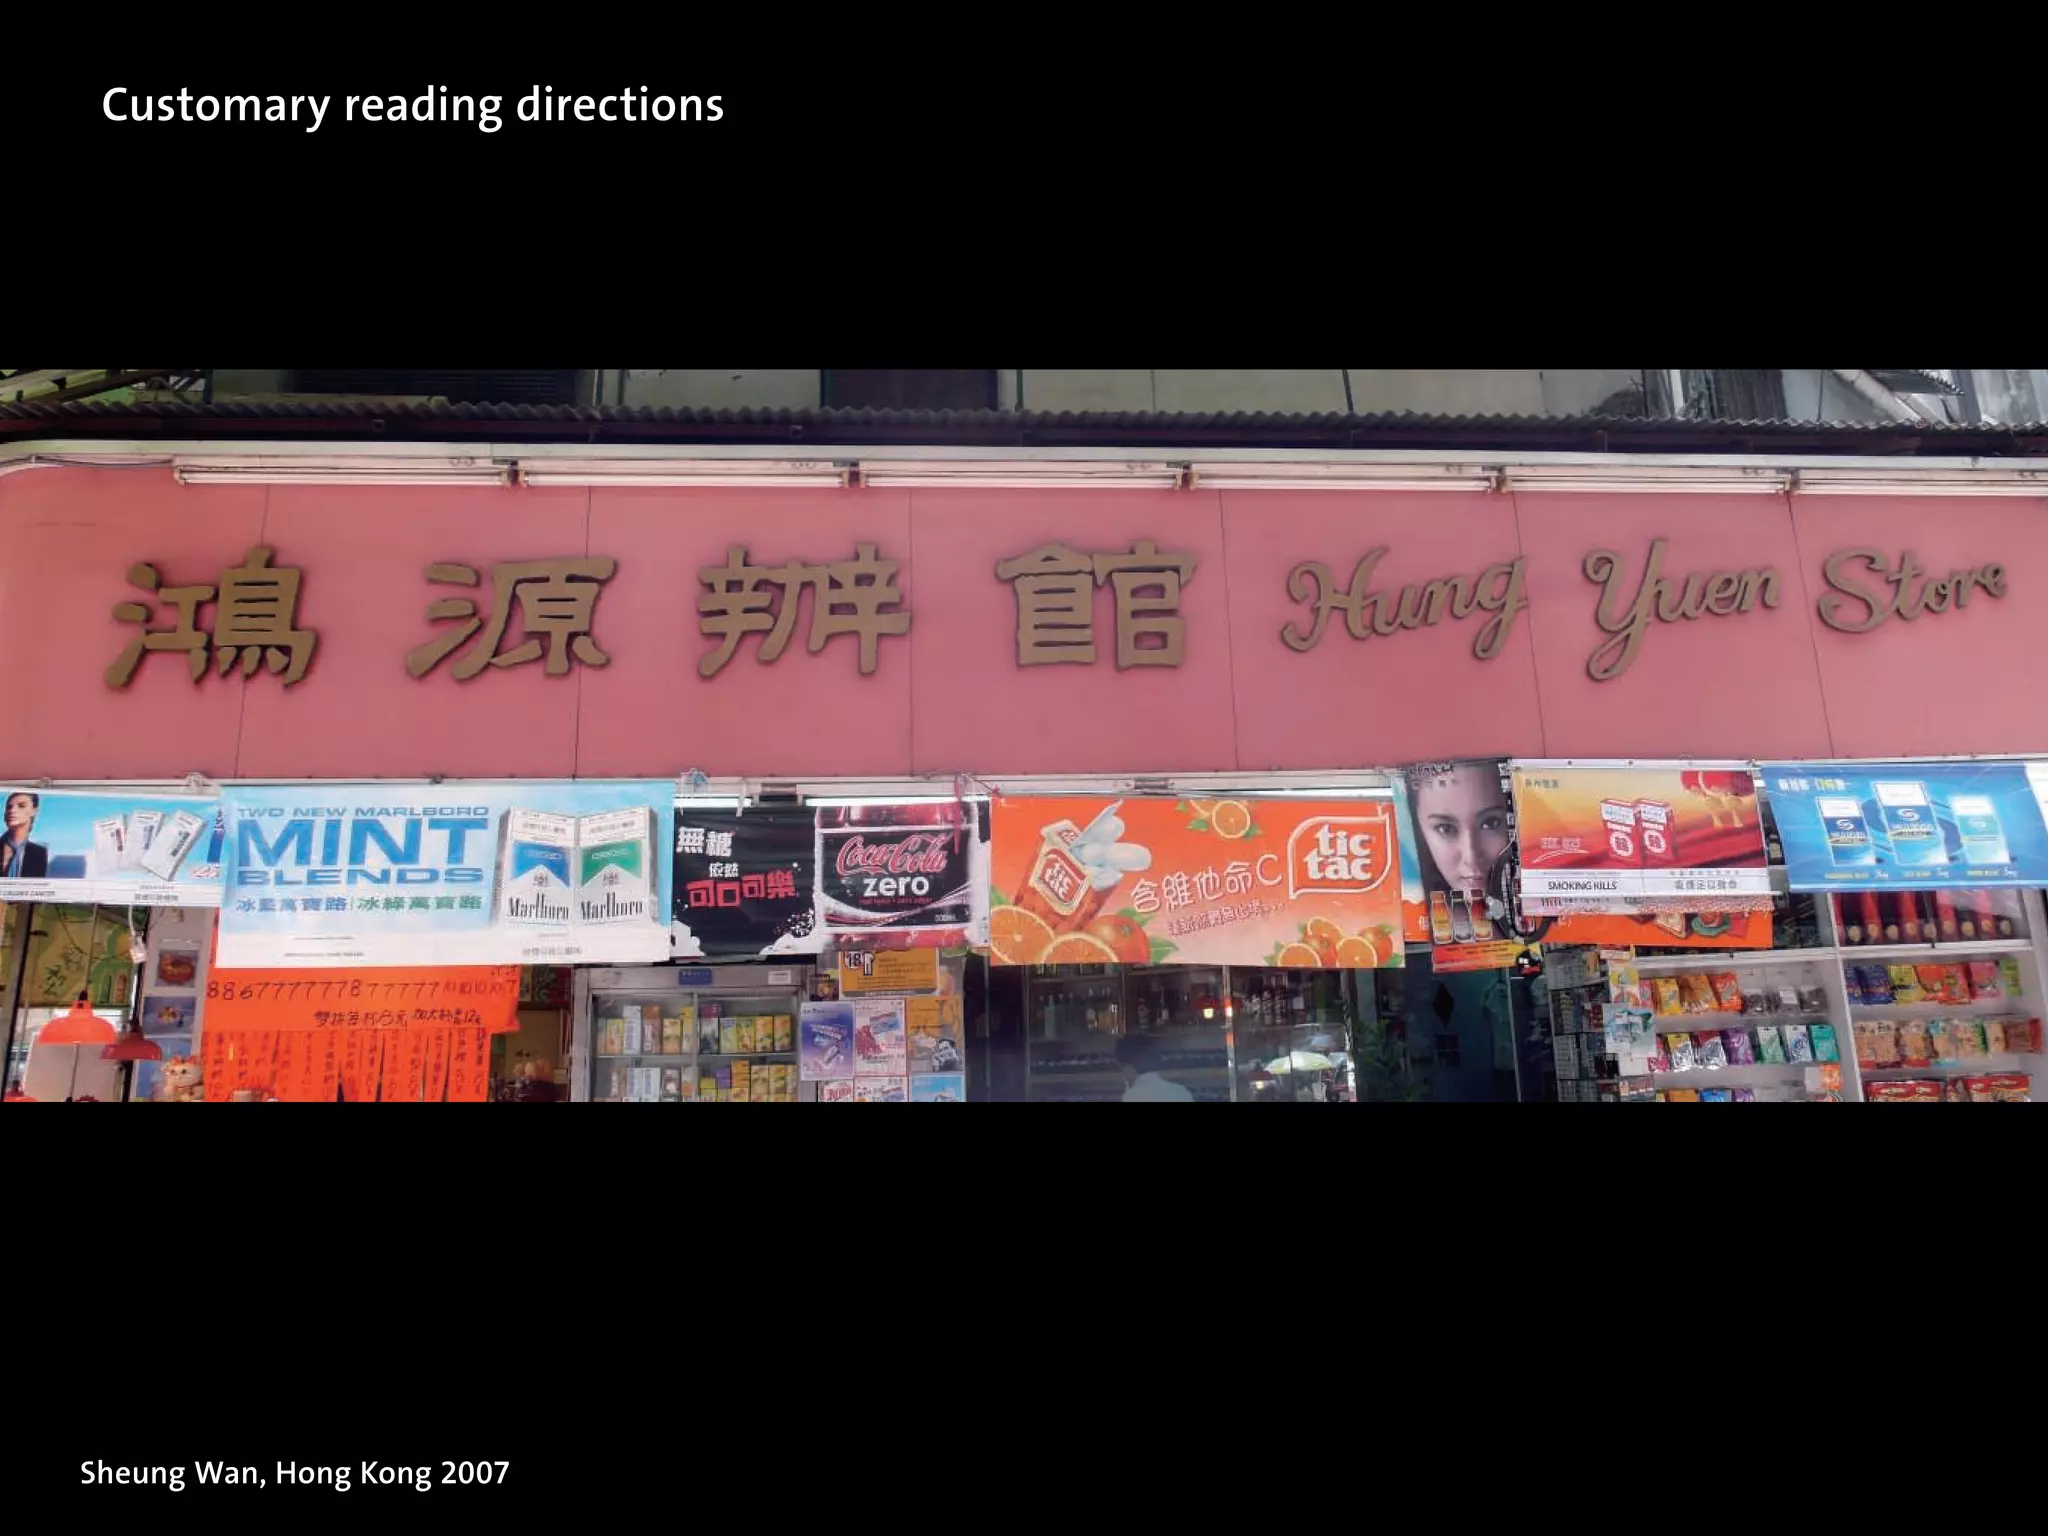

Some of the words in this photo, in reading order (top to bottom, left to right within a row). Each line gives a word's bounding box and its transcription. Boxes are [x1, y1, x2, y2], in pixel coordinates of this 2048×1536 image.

[1280, 546, 1528, 661] Hung
[1583, 538, 1779, 682] Yuen
[1817, 547, 2008, 634] Store
[238, 807, 285, 818] TWO
[293, 807, 347, 818] NEW
[355, 806, 489, 817] MARLBORO
[237, 817, 489, 868] MINT
[676, 826, 734, 857] 無糖
[836, 832, 953, 876] Coca-Cola
[1314, 823, 1374, 857] tic
[237, 868, 484, 886] BLENDS
[709, 862, 739, 878] 依然
[1304, 848, 1372, 880] tac
[686, 869, 797, 908] 可口可樂
[863, 875, 930, 897] zero
[1548, 881, 1592, 891] SMOKING
[1593, 881, 1618, 891] KILLS
